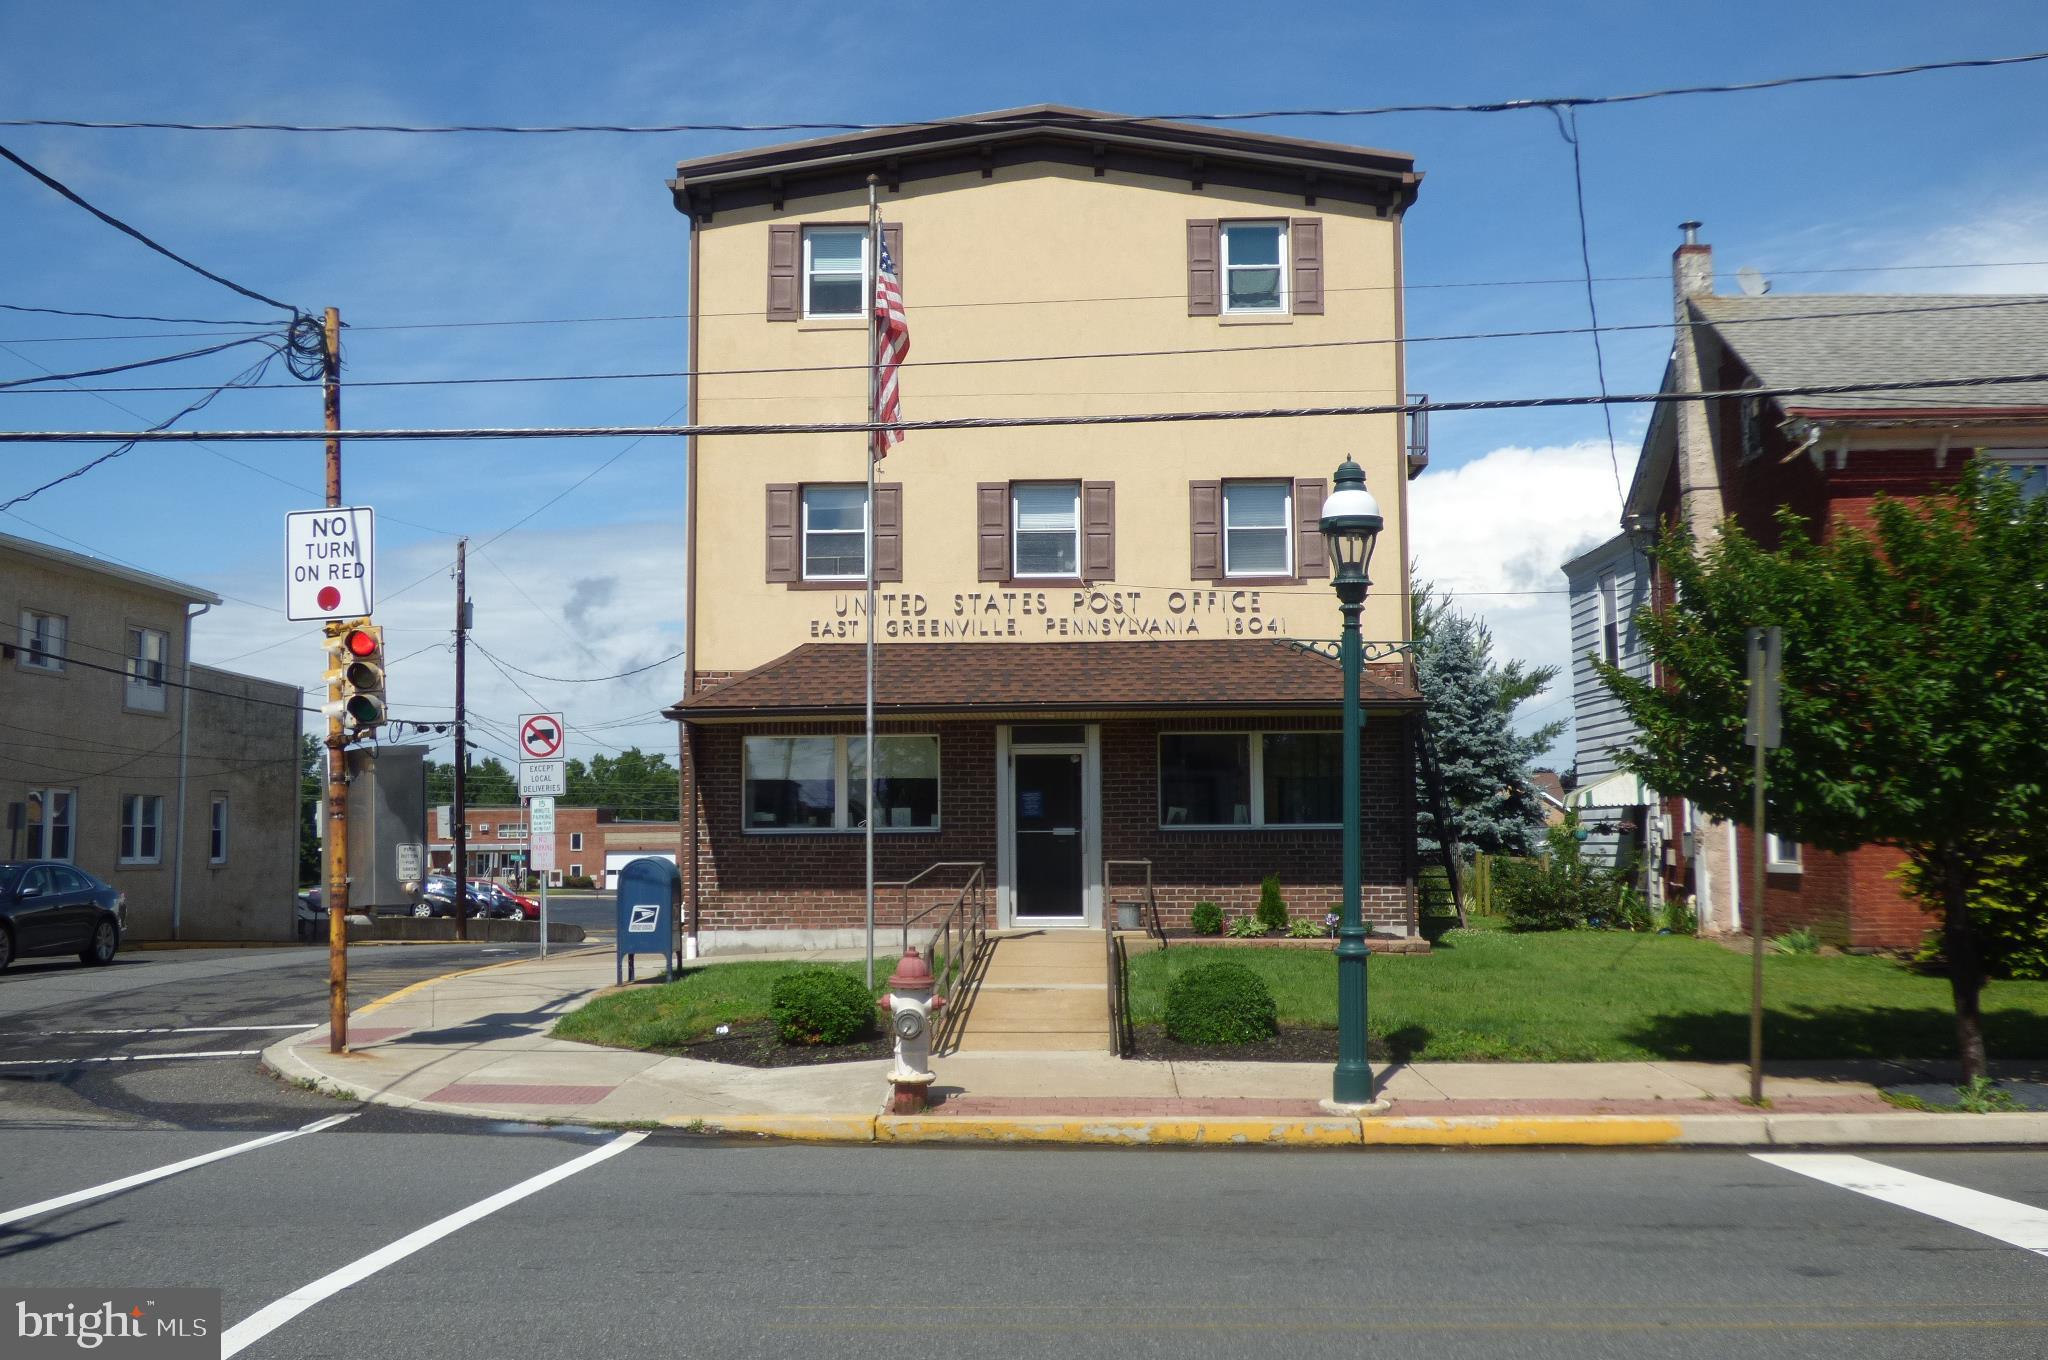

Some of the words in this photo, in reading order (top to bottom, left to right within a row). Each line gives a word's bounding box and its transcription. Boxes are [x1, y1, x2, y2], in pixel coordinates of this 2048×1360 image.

[313, 517, 346, 537] NO
[305, 541, 355, 560] TURN
[295, 565, 319, 582] ON
[329, 562, 365, 580] RED
[835, 593, 928, 617] UNITED
[953, 592, 1047, 615] STATES
[1073, 592, 1141, 614] POST
[1168, 591, 1261, 614] OFFICE
[810, 620, 859, 637] EAST
[1046, 617, 1199, 636] PENNSYLVANIA
[1226, 617, 1286, 635] 18041
[529, 764, 554, 773] EXCEPT
[531, 774, 552, 783] LOCAL
[523, 784, 561, 793] DELIVERIES
